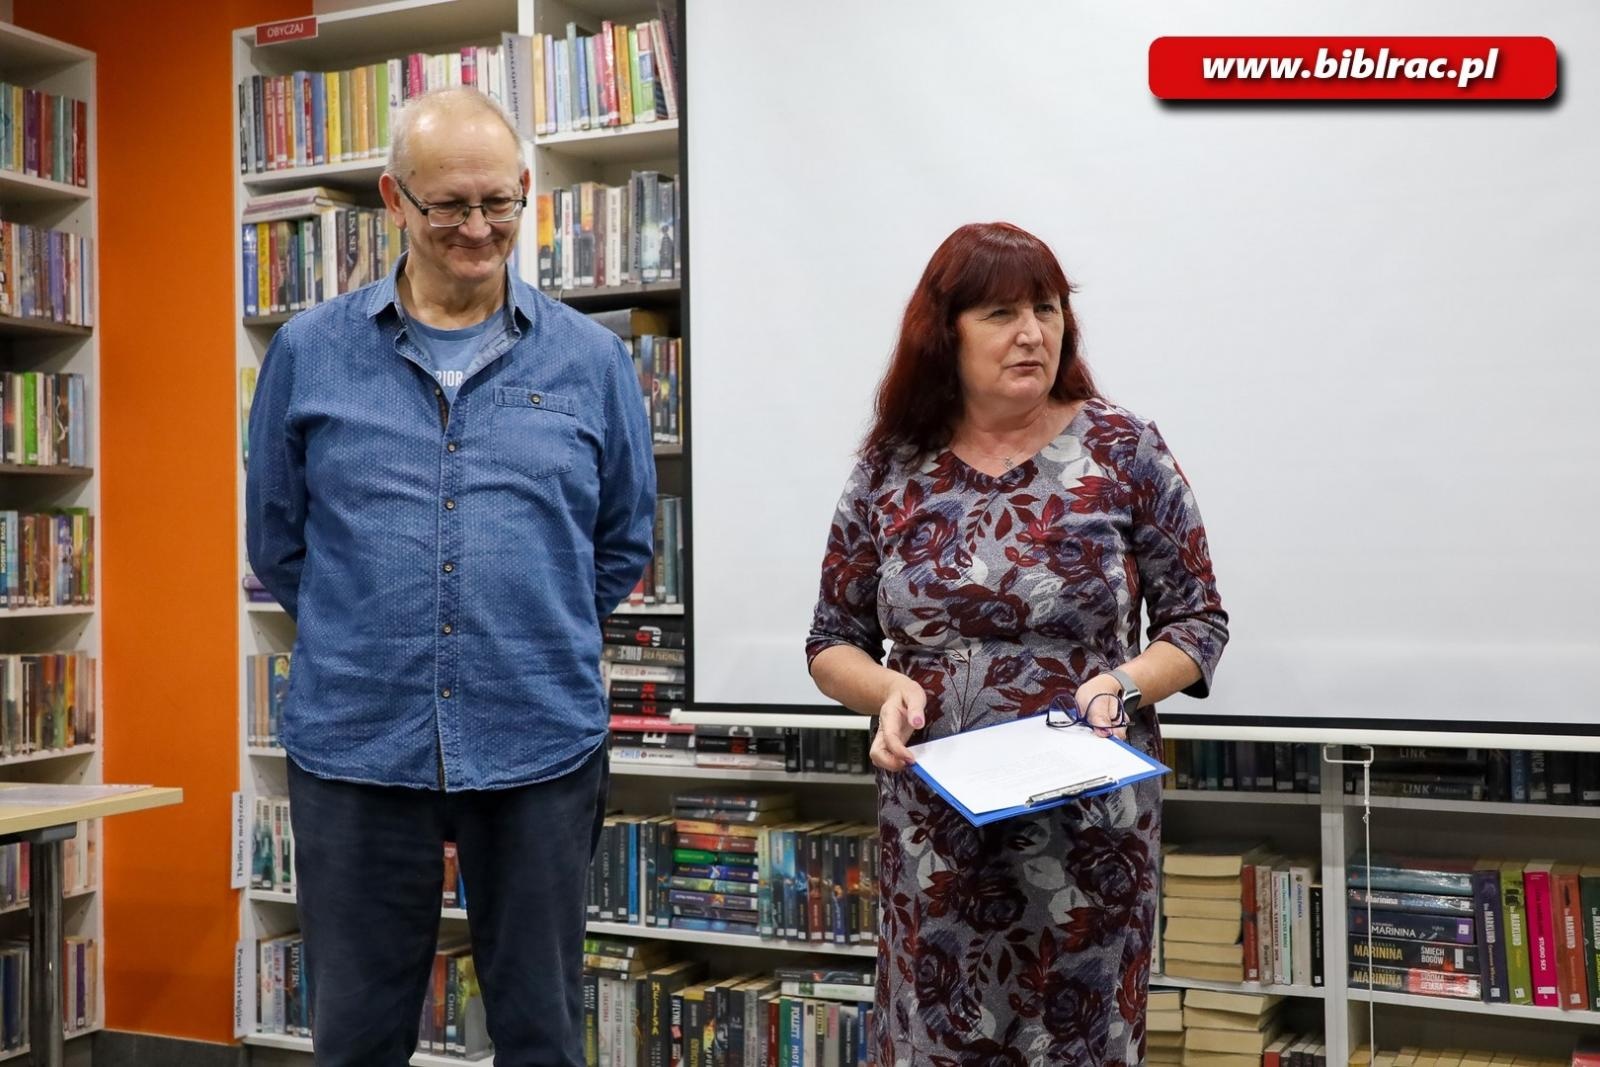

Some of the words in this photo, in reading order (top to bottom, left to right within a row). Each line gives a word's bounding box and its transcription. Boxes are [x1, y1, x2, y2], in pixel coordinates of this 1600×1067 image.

[267, 23, 304, 38] OBYCZAJ
[348, 211, 356, 233] LISA
[349, 235, 357, 253] SEE
[1400, 748, 1427, 759] LINK
[1402, 784, 1431, 794] LINK
[237, 840, 245, 878] Thrillery
[1371, 926, 1417, 938] MARININA
[1484, 911, 1496, 943] MARKLUND
[1511, 913, 1521, 946] MARKLUND
[1565, 916, 1575, 949] MARKLUND
[1353, 945, 1403, 960] MARININA
[1421, 946, 1444, 956] ŚMIECH
[1421, 954, 1444, 965] BOGÓW
[291, 947, 300, 988] RIVERS
[1353, 970, 1402, 987] MARININA
[447, 993, 455, 1020] CHATA
[791, 1006, 800, 1039] FOLLETT
[791, 1045, 799, 1063] MŁOT
